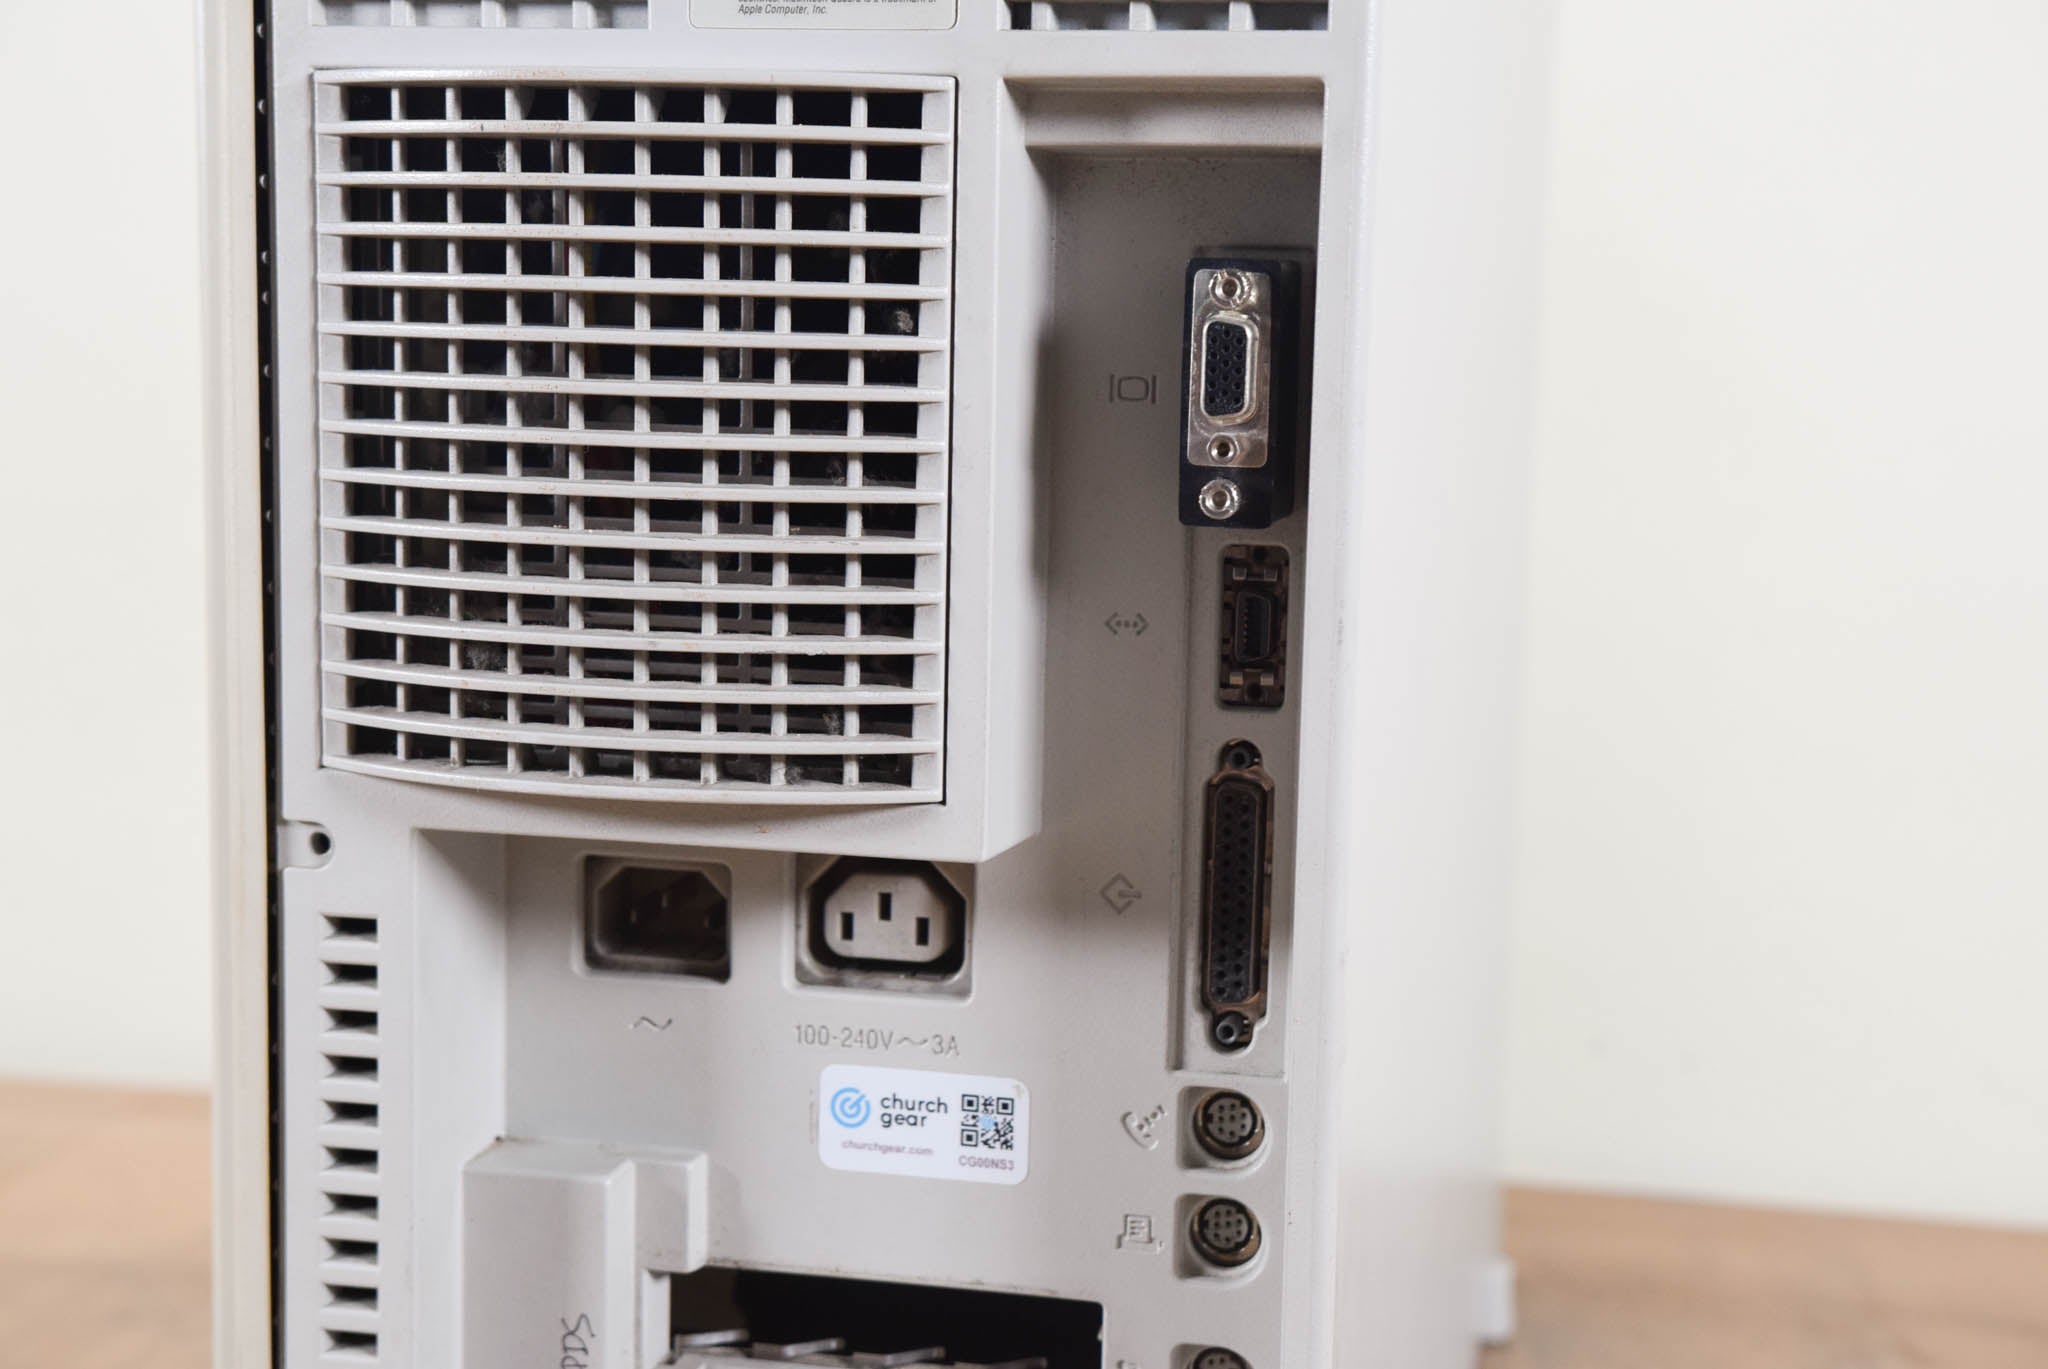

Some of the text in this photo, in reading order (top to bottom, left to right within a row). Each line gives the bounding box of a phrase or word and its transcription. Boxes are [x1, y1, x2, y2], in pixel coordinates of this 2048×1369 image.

[738, 4, 763, 15] Apple
[764, 4, 809, 16] Computer,
[880, 1093, 948, 1114] church
[880, 1112, 927, 1128] gear
[842, 1139, 934, 1156] churchgear.com
